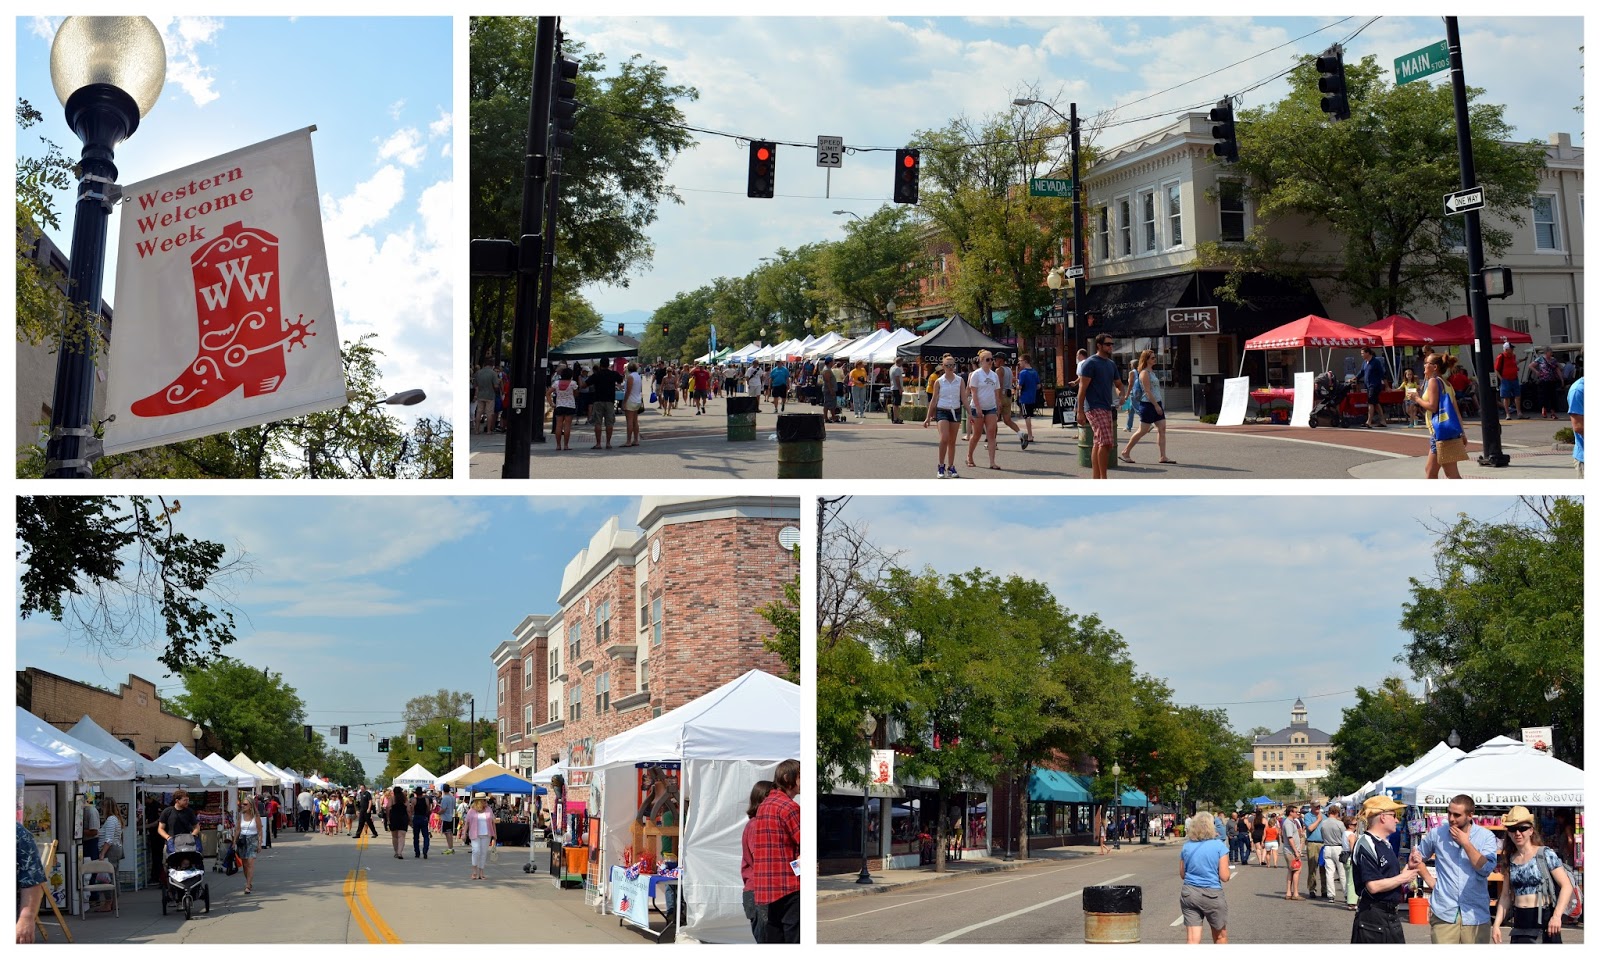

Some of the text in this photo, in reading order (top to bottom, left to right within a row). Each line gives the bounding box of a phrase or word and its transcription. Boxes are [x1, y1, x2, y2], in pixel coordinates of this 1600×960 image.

[1401, 52, 1430, 78] MAIN
[1440, 41, 1447, 50] ST
[1431, 57, 1450, 71] 5700 S
[819, 152, 840, 164] 25
[138, 167, 243, 211] Western
[1034, 180, 1067, 192] NEVADA
[1454, 193, 1479, 207] ONE WAY
[137, 188, 253, 234] Welcome
[135, 225, 206, 259] Week
[1170, 311, 1211, 322] CHR
[924, 355, 966, 363] COLODO
[1424, 791, 1582, 806] Coloo Frame & Savvy
